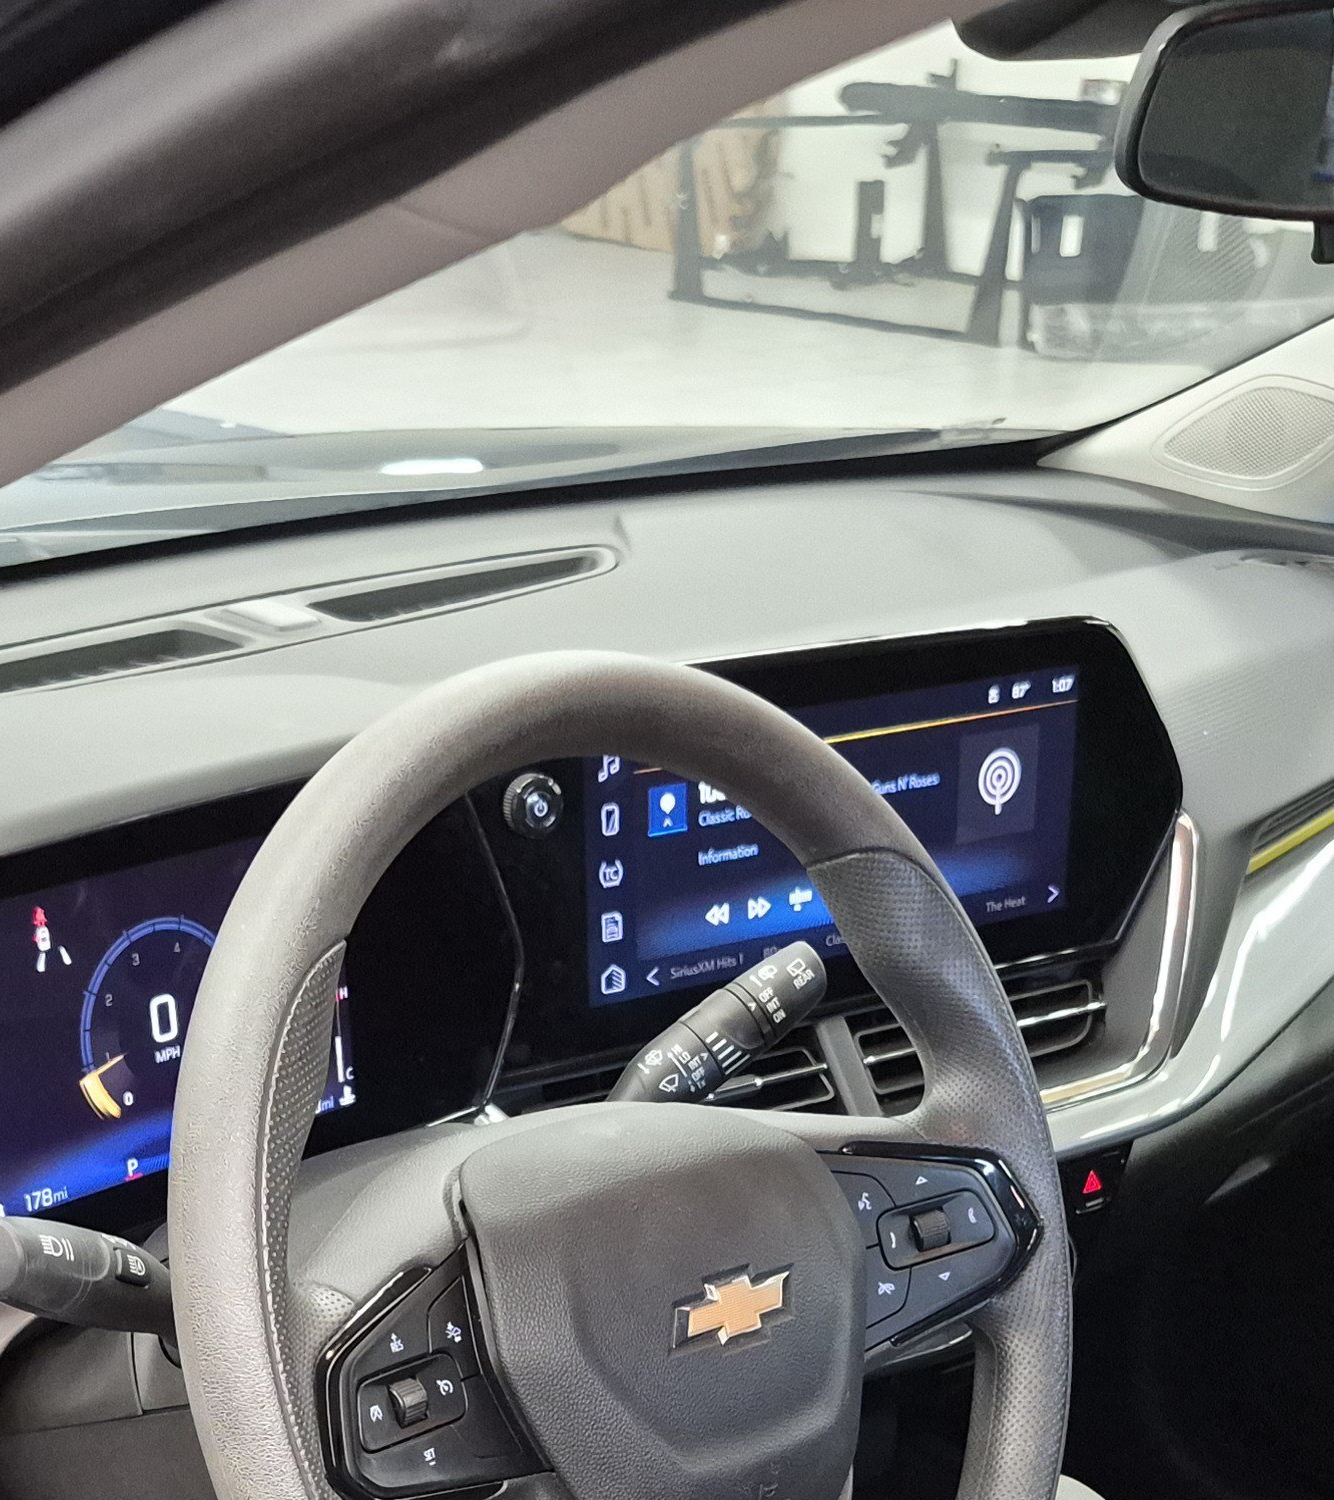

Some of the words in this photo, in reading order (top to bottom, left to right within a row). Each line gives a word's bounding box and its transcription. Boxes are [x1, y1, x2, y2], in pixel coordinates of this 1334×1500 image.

[1052, 675, 1074, 693] 1:07
[909, 772, 940, 789] Roses
[698, 808, 734, 827] Classic
[698, 843, 759, 866] Information
[986, 901, 1003, 912] The
[1004, 895, 1026, 909] Heat
[131, 952, 140, 966] 3
[670, 959, 715, 979] SiriusXM
[717, 956, 737, 971] Hits
[793, 969, 815, 990] REAR
[105, 994, 113, 1007] 2
[759, 987, 774, 1002] OFF
[766, 997, 781, 1014] INT
[149, 993, 178, 1043] 0
[773, 1009, 786, 1023] ON
[154, 1045, 181, 1063] MPH
[122, 1091, 134, 1106] 0
[126, 1159, 139, 1177] P
